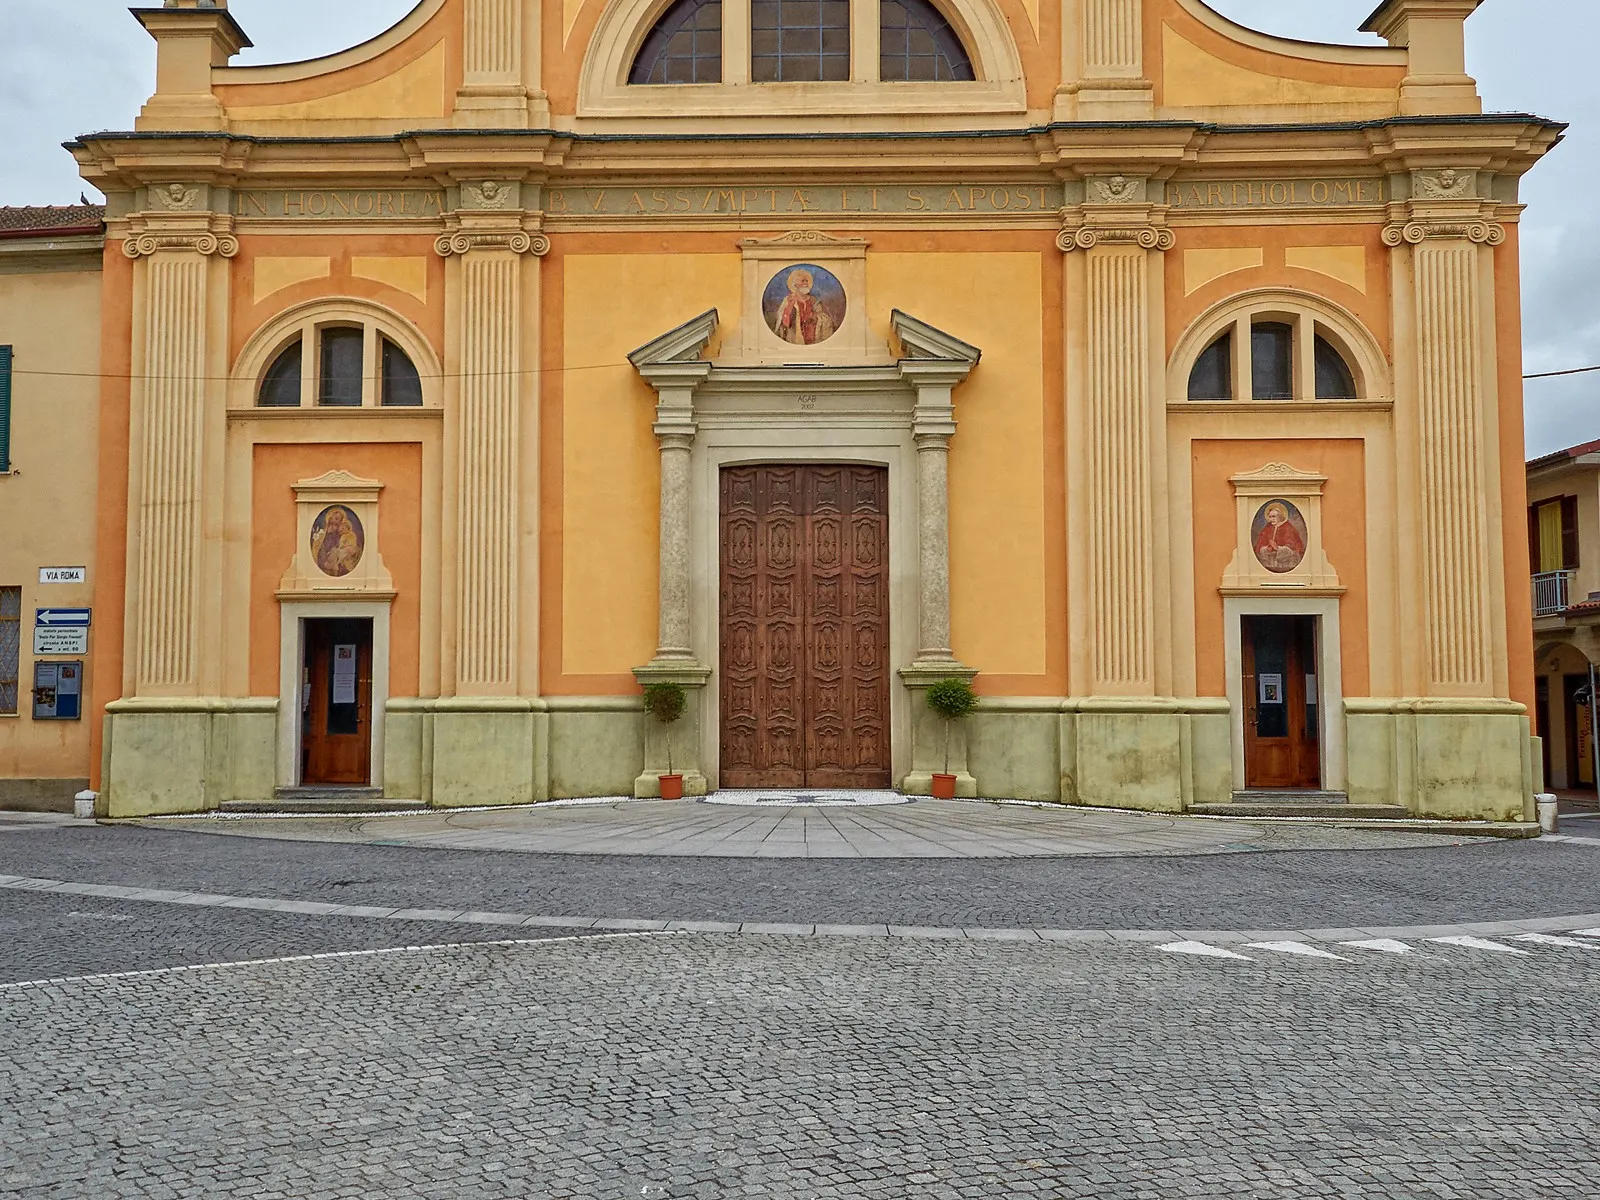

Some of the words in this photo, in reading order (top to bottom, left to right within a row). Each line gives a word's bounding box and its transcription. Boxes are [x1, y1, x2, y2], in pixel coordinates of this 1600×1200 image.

[237, 191, 267, 216] IN
[283, 192, 445, 216] HONOREM
[548, 190, 573, 213] B.
[586, 189, 607, 212] V.
[841, 187, 884, 212] ET
[906, 187, 930, 211] S.
[944, 186, 1056, 211] APOST.
[1165, 180, 1385, 208] BARTHOLOMEI
[46, 571, 58, 580] VIA
[60, 571, 80, 580] ROMA
